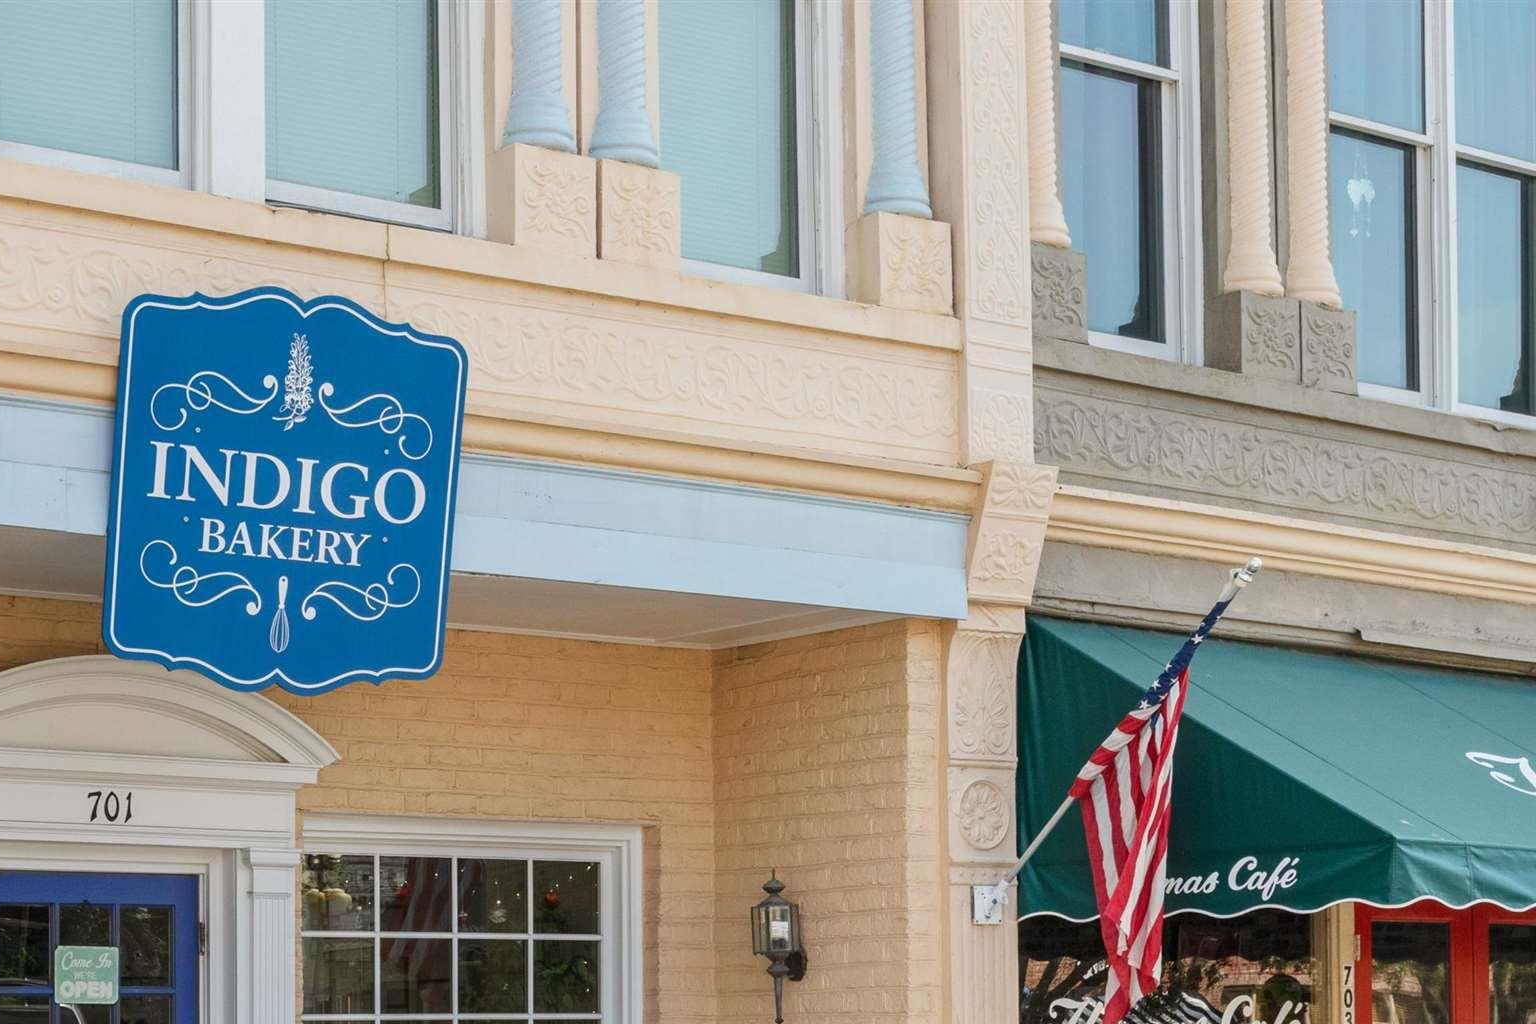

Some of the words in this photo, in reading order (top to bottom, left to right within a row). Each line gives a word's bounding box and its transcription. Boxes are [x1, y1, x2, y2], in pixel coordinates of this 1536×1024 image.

[146, 440, 427, 525] INDIGO
[198, 516, 372, 567] BAKERY
[87, 791, 132, 824] 701
[1164, 871, 1219, 895] mas
[1228, 855, 1300, 901] Café
[60, 981, 113, 999] OPEN
